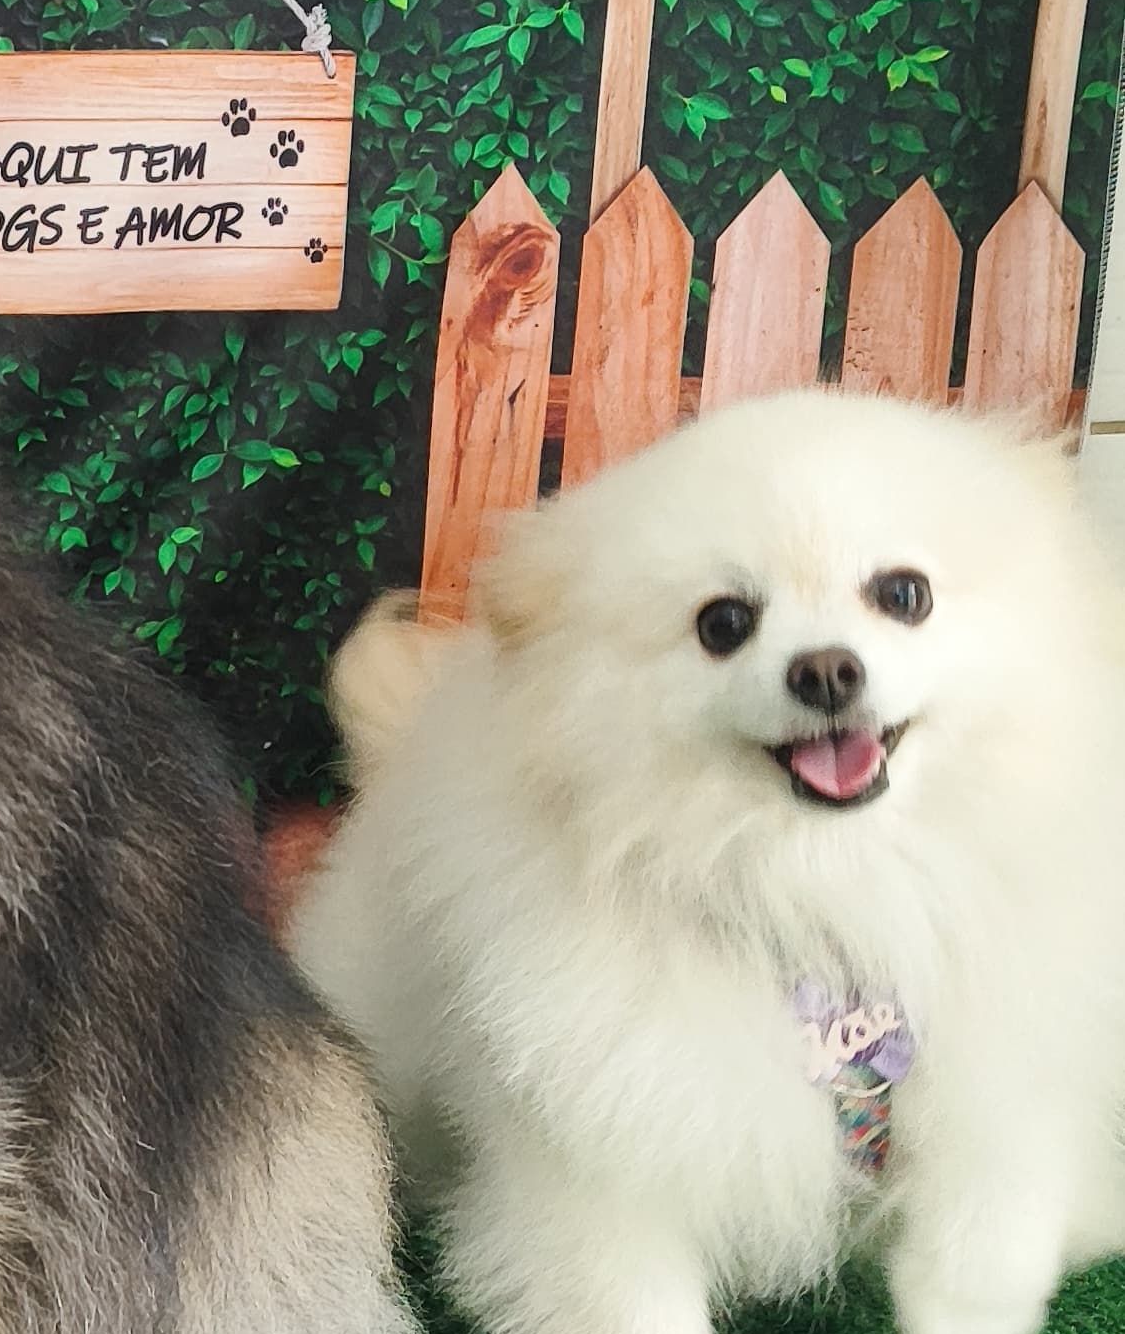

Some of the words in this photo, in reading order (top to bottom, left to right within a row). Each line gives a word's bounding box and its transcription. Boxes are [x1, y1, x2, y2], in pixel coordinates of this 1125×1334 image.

[109, 142, 207, 181] TEM
[77, 206, 110, 243] E
[115, 202, 244, 249] AMOR
